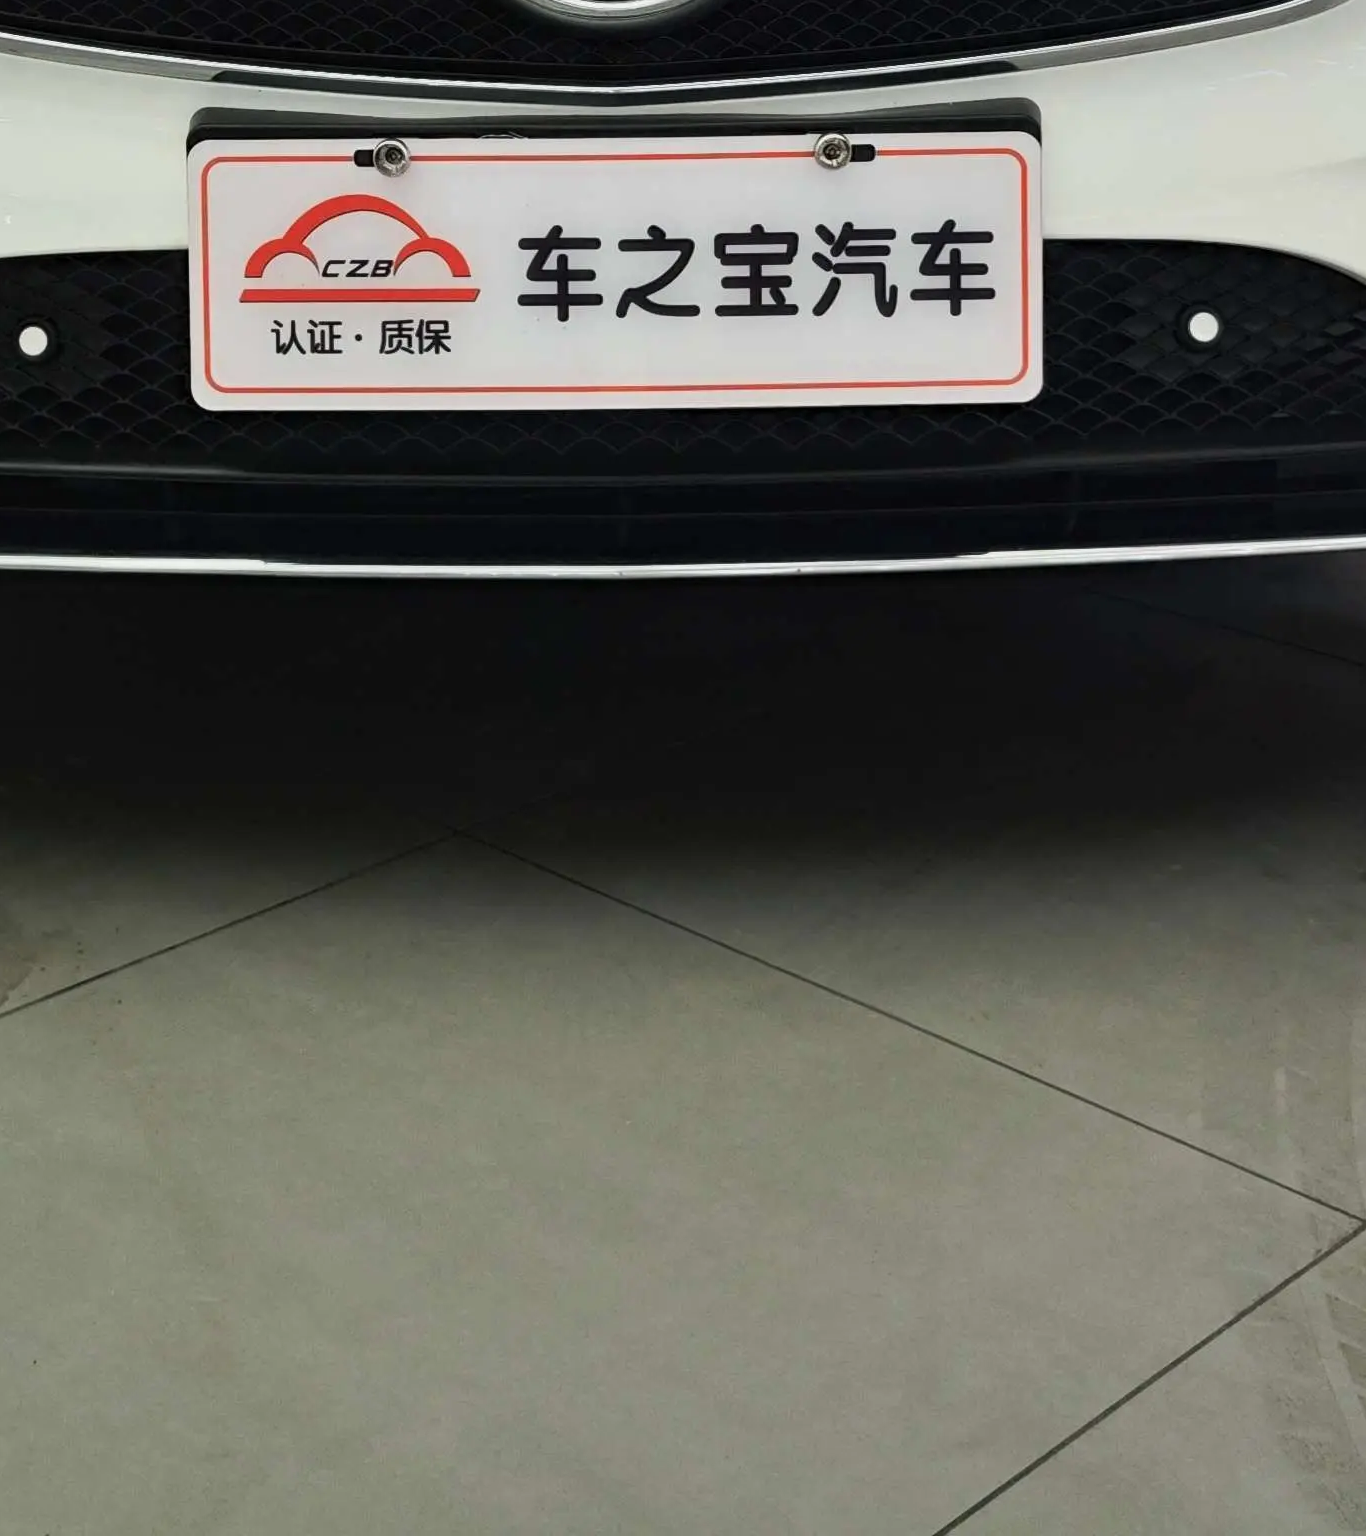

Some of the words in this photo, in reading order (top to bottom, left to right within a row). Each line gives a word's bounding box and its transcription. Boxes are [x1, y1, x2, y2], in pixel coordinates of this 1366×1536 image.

[322, 260, 393, 279] CZB
[516, 218, 996, 322] 车之宝汽车
[271, 319, 452, 355] 认证·质保
